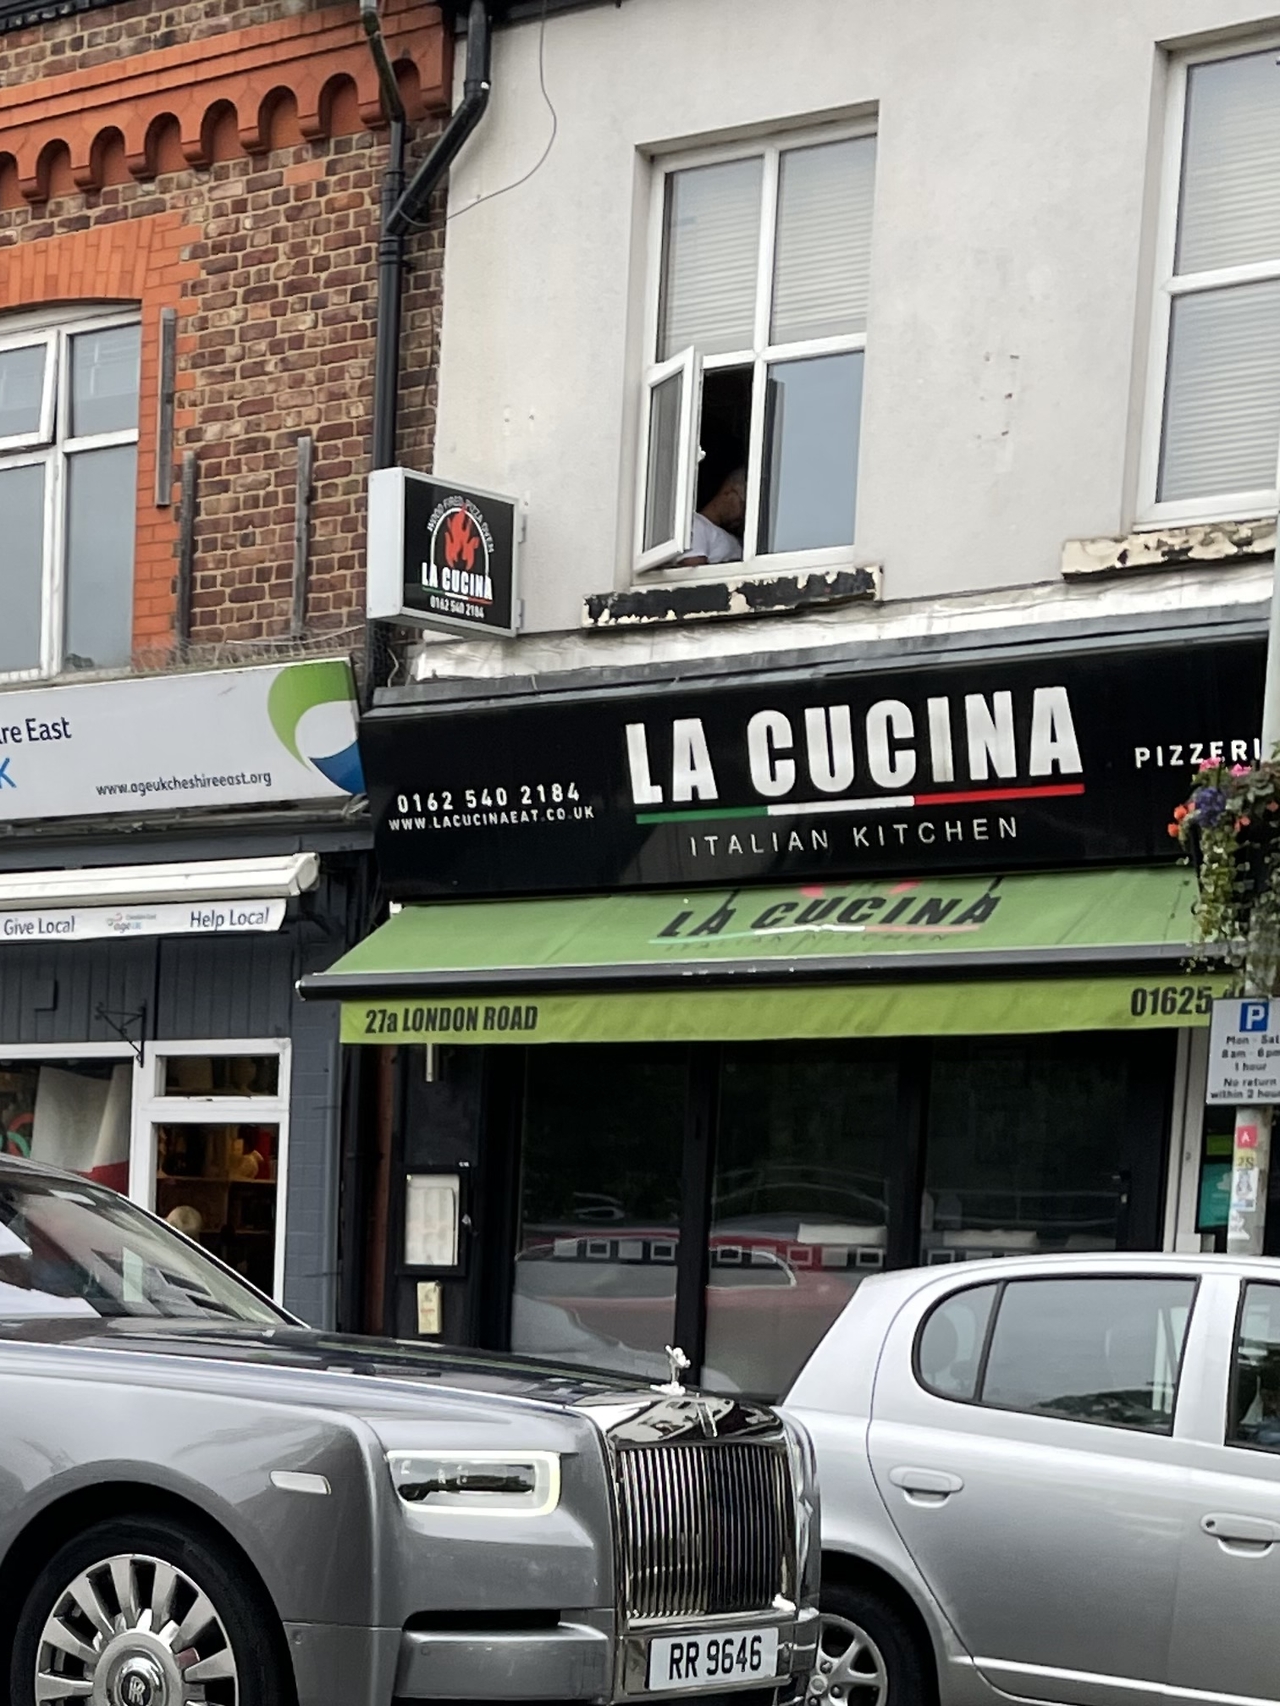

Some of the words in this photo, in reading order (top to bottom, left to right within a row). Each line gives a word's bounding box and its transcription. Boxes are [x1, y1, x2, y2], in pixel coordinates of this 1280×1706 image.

[422, 562, 438, 588] LA
[442, 566, 493, 600] CUCINA
[25, 716, 72, 742] East
[625, 717, 719, 804] LA
[746, 686, 1084, 798] CUCINA
[96, 772, 272, 797] www.ageukcheshireeast.org
[397, 791, 454, 813] 0162
[465, 787, 507, 809] 540
[520, 782, 580, 805] 2184
[388, 806, 595, 831] WWW.LACUCINAEAT.CO.UK
[689, 829, 829, 858] ITALIAN
[853, 816, 1018, 849] KITCHEN
[3, 918, 34, 936] Give
[38, 915, 75, 934] Local
[190, 911, 225, 931] Help
[229, 907, 270, 926] Local
[656, 905, 736, 937] LA
[751, 896, 1002, 930] CUCINA
[1131, 986, 1212, 1016] 01625
[365, 1009, 398, 1034] 27a
[402, 1006, 479, 1032] LONDON
[483, 1005, 539, 1031] ROAD
[1226, 1035, 1250, 1045] Mon
[1261, 1034, 1280, 1045] Sat
[1243, 1062, 1267, 1071] hour
[1211, 1089, 1243, 1099] within
[1224, 1077, 1239, 1087] No
[1242, 1077, 1277, 1087] return
[669, 1641, 699, 1680] RR
[706, 1635, 762, 1676] 9646
